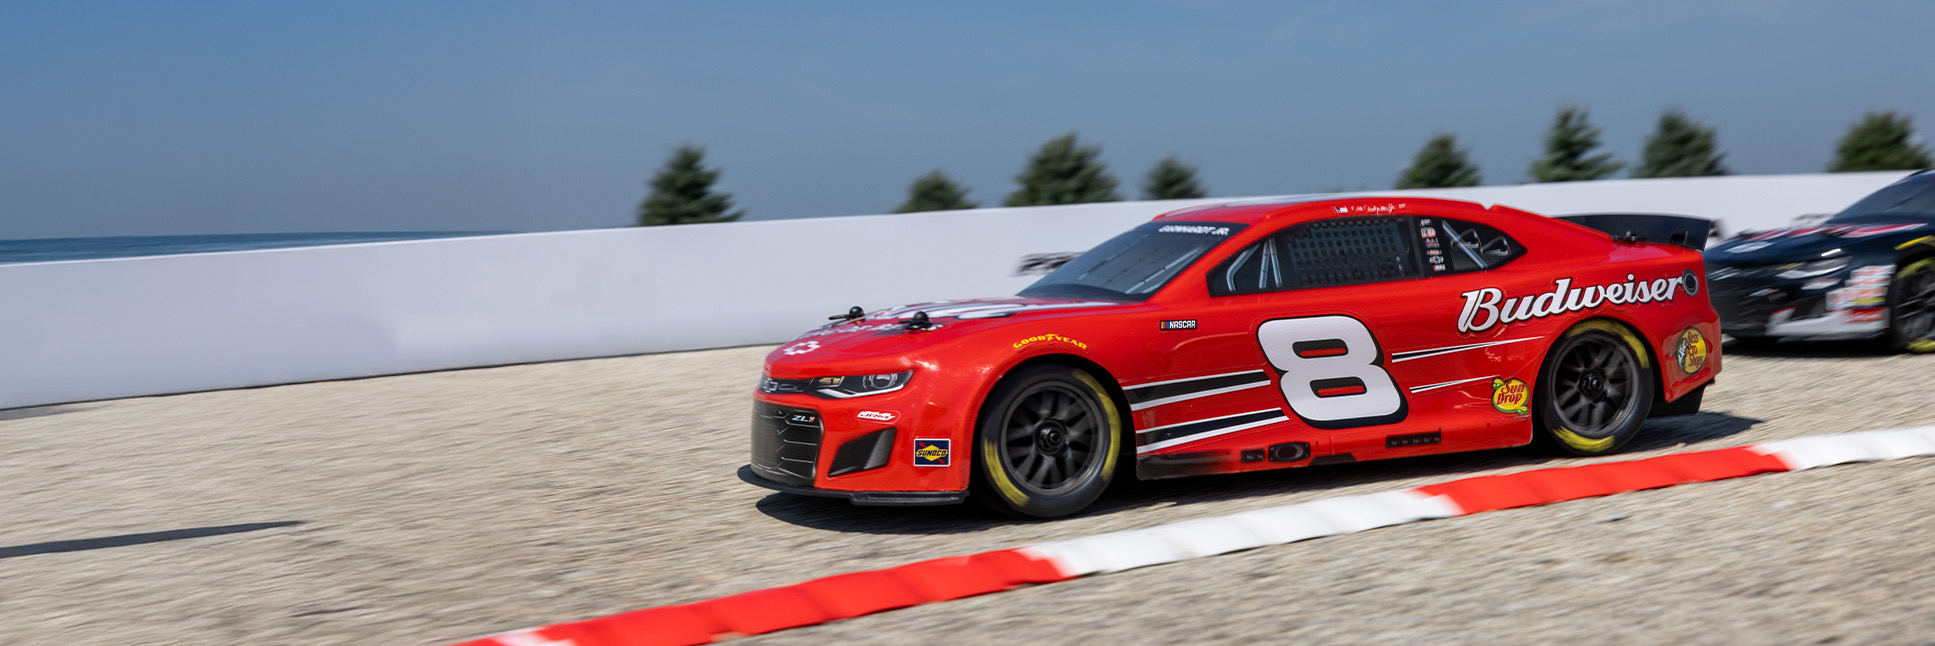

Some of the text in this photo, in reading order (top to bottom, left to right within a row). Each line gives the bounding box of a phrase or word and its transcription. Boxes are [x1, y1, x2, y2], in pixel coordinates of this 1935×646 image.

[1456, 273, 1683, 334] Budweiser
[1169, 320, 1196, 329] NASCAR
[1012, 333, 1088, 350] GOODYEAR
[1687, 331, 1699, 344] Bass
[1688, 343, 1698, 356] Pro
[1688, 354, 1704, 369] Shops
[1257, 314, 1406, 427] 8
[1500, 381, 1526, 395] Sun
[1496, 393, 1523, 405] Drop
[916, 449, 948, 458] SUNOCO
